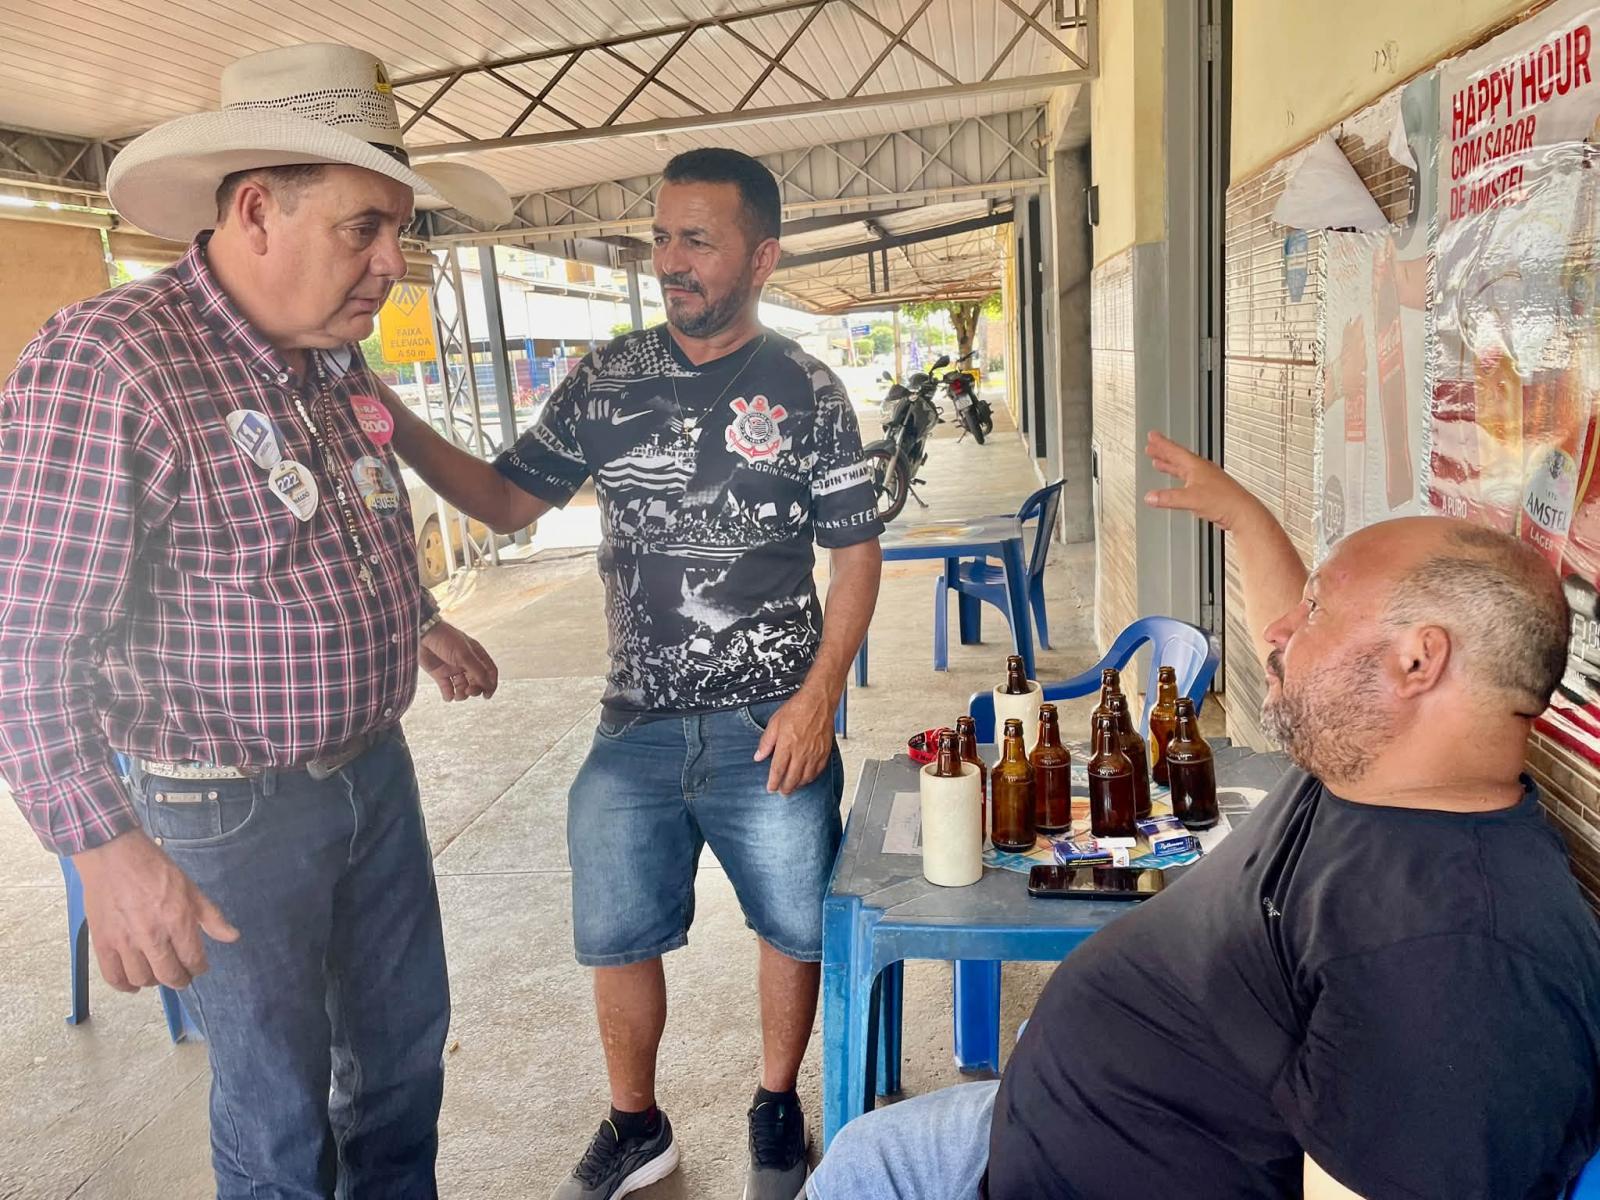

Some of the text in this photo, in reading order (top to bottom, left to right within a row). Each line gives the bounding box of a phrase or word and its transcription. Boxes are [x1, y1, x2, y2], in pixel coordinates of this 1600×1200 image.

[1452, 24, 1592, 141] HAPPY HOUR
[1451, 114, 1536, 181] COM SABOR
[1450, 184, 1465, 221] DE
[391, 338, 431, 348] ELEVADA
[397, 328, 422, 337] FAIXA
[277, 473, 300, 492] 222
[1526, 491, 1567, 531] AMSTEL
